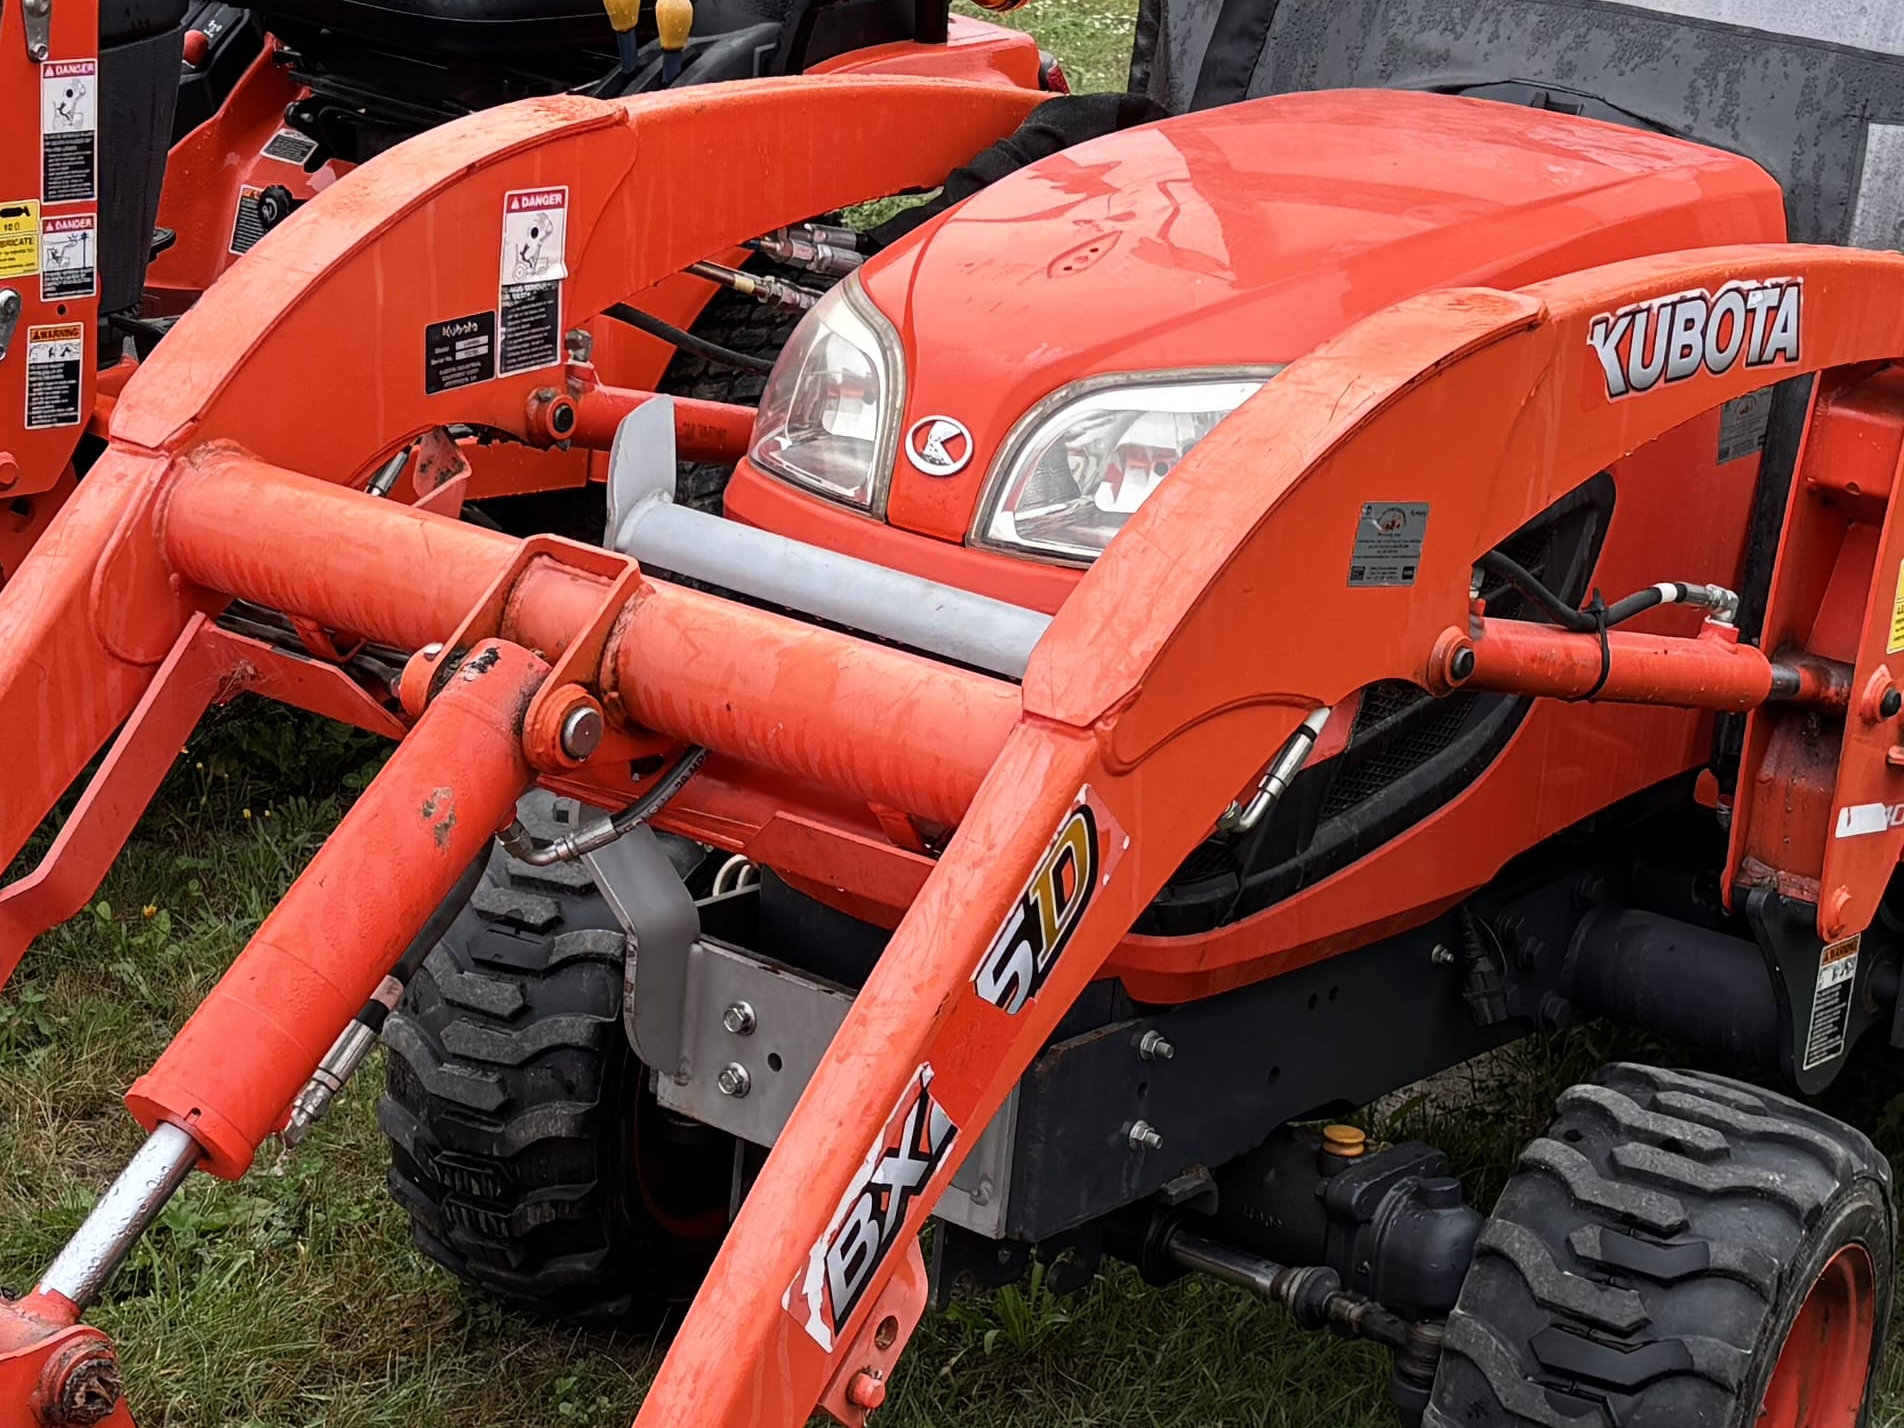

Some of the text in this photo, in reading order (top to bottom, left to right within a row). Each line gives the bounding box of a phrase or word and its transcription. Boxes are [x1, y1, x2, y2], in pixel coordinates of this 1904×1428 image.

[55, 62, 94, 75] DANGER
[522, 193, 562, 208] DANGER
[55, 218, 93, 231] DANGER
[1589, 281, 1803, 400] KUBOTA
